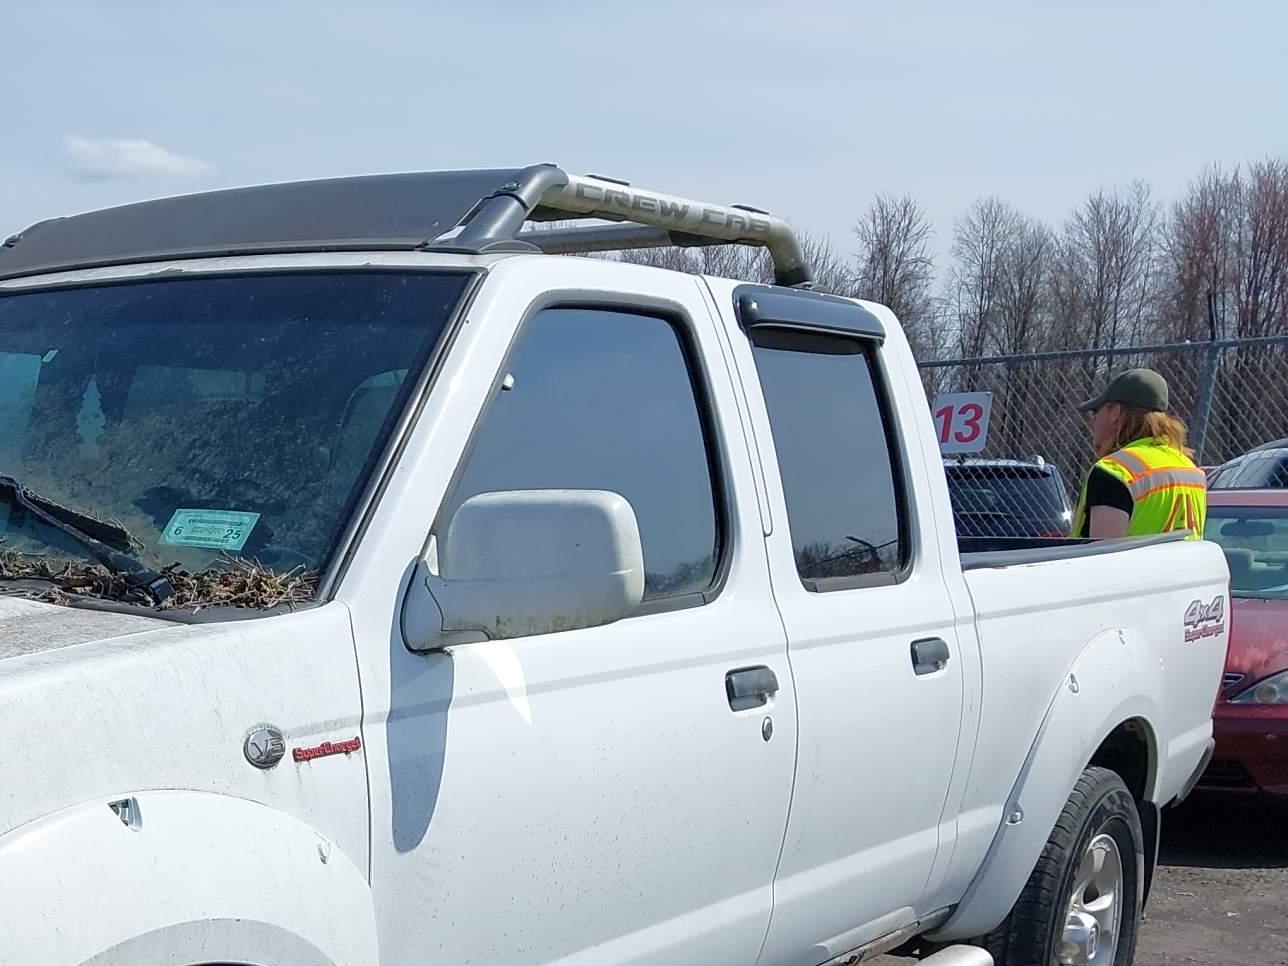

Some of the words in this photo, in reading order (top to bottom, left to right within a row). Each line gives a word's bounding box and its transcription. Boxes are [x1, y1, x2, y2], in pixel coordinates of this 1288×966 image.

[576, 183, 690, 219] CREW
[702, 208, 771, 232] CAB
[936, 403, 984, 443] 13
[174, 526, 184, 536] 6
[222, 528, 243, 540] 25
[1184, 595, 1225, 628] 4x4
